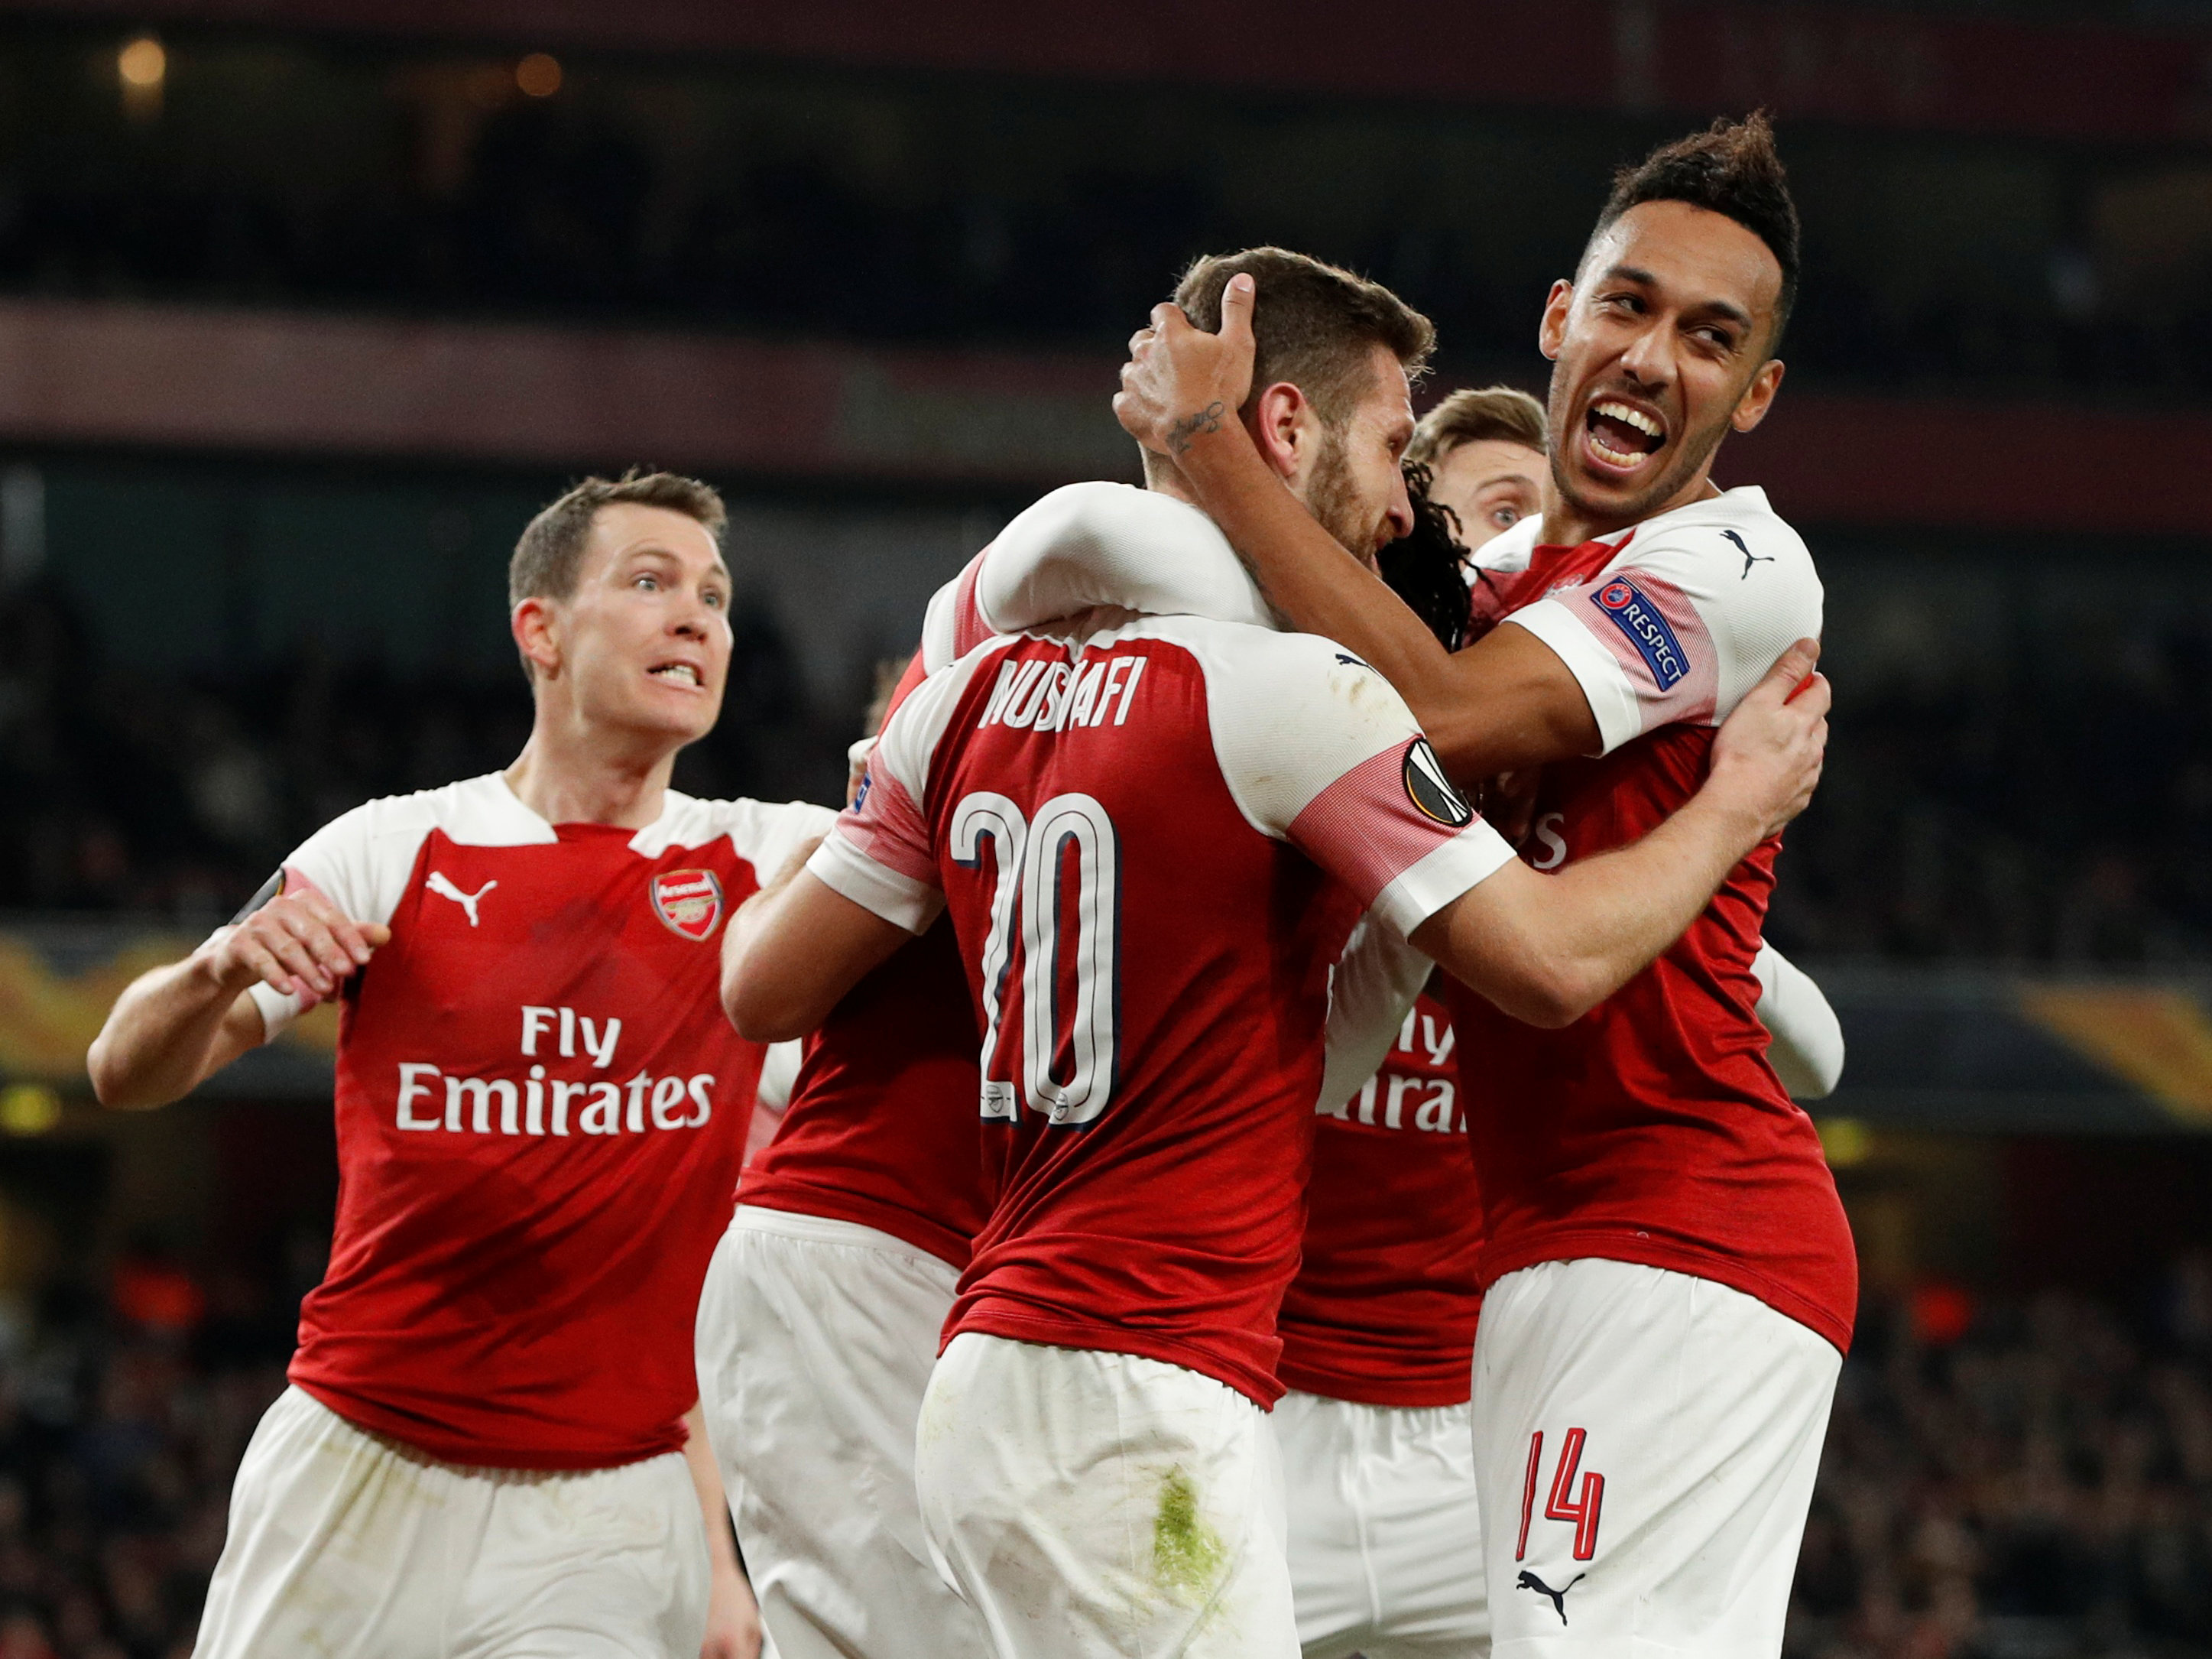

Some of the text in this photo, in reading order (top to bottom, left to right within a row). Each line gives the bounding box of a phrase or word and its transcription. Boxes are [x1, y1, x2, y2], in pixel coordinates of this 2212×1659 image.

[1622, 602, 1682, 682] RESPECT
[659, 880, 712, 898] Arsenal
[950, 791, 1121, 1130] 20
[521, 1005, 621, 1068] Fly
[1398, 1005, 1455, 1066] ly
[396, 1063, 715, 1136] Emirates
[1516, 1427, 1604, 1562] 14
